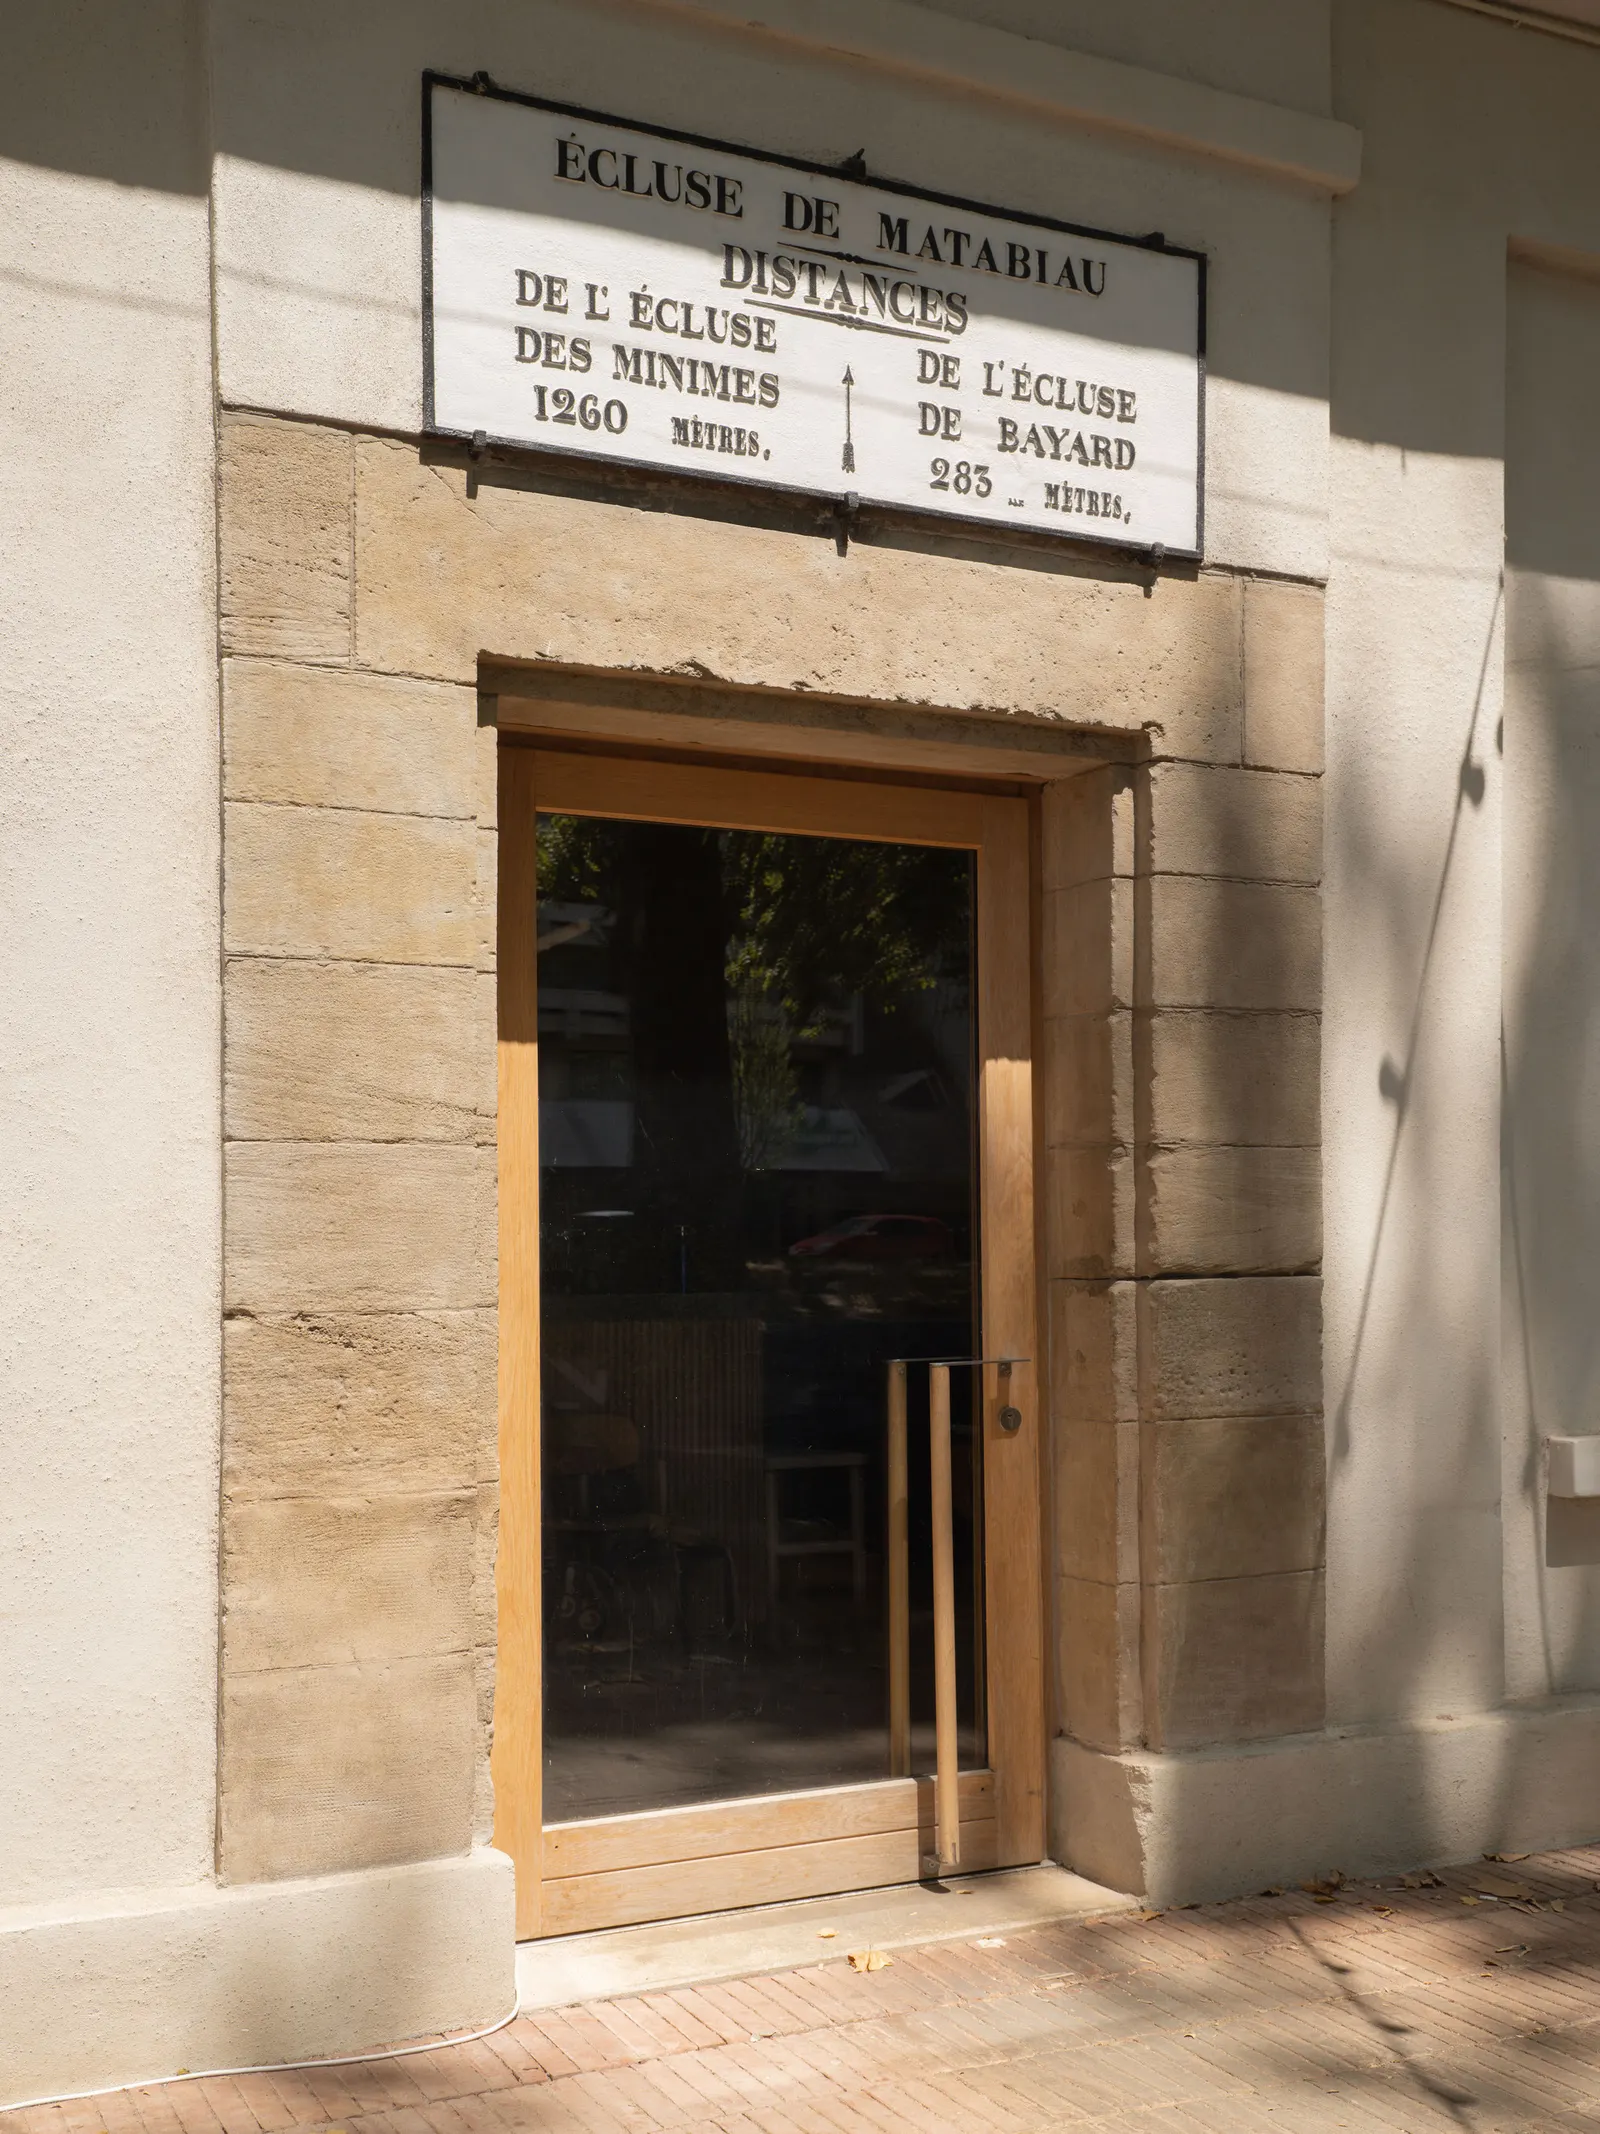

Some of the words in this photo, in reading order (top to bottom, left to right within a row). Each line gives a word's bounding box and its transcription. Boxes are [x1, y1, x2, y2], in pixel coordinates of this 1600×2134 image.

[554, 132, 743, 218] ÉCLUSE
[782, 190, 840, 239] DE
[877, 212, 1107, 296] MATABIAU
[514, 268, 568, 314] DE
[629, 284, 777, 352] ÉCLUSE
[720, 244, 968, 334] DISTANCES
[514, 325, 592, 372] DES
[612, 344, 780, 407] MINIMES
[917, 348, 961, 390] DE
[533, 385, 628, 434] 1260
[918, 401, 962, 441] DE
[998, 417, 1136, 470] BAYARD
[930, 458, 992, 498] 283
